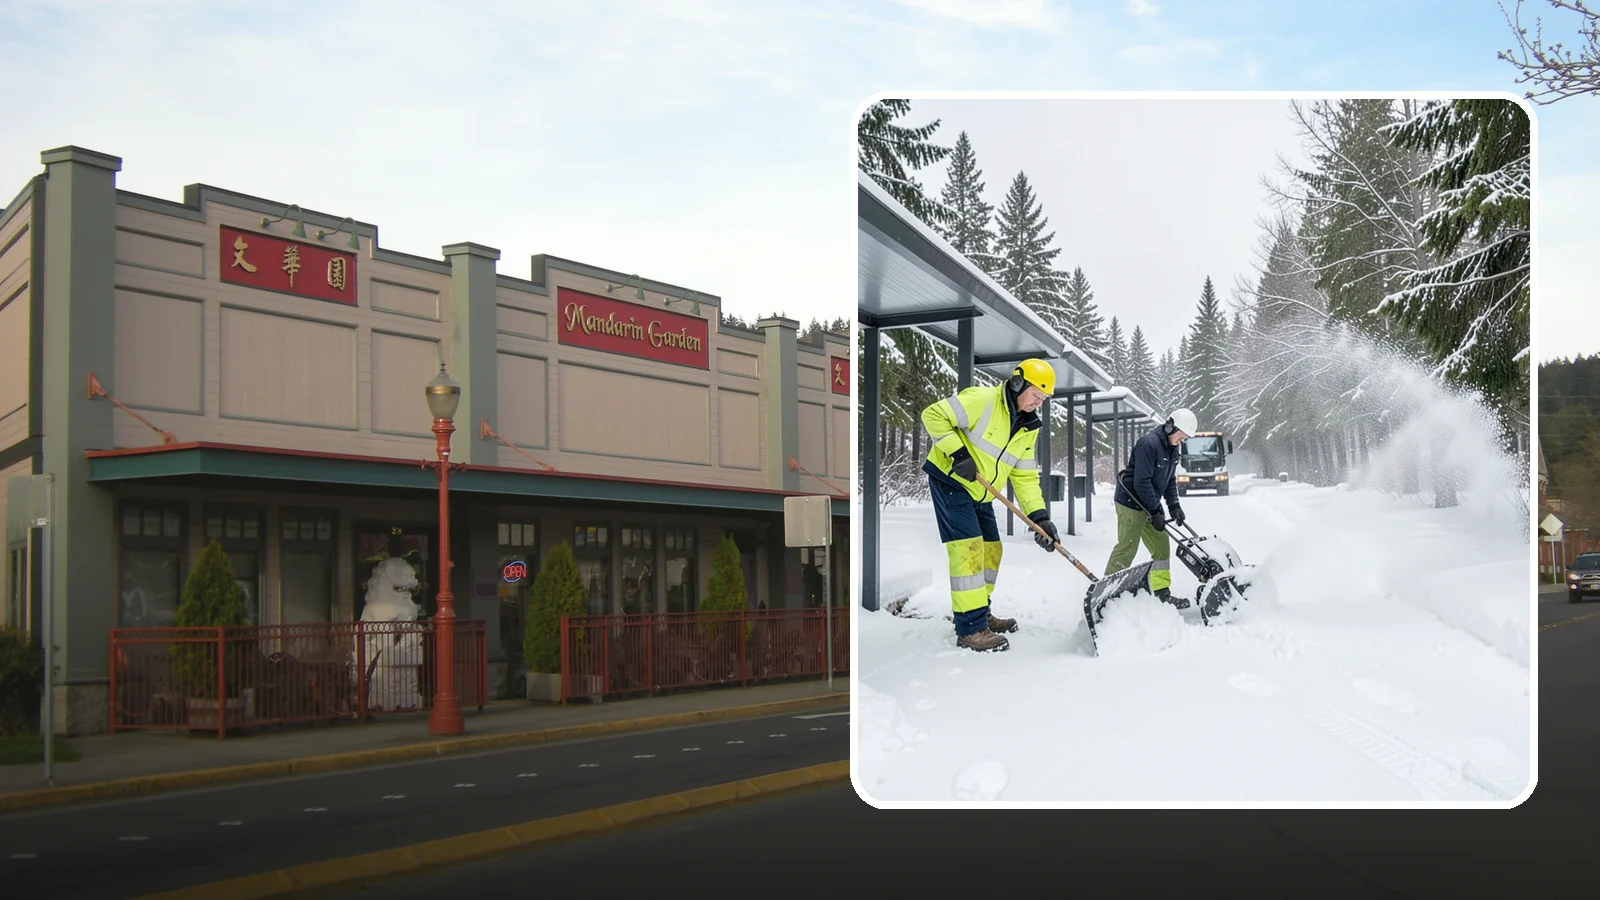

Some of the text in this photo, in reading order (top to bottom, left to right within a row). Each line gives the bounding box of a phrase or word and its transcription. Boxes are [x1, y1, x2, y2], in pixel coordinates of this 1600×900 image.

[231, 236, 346, 290] 文華園
[564, 302, 702, 352] Mandarin Garden
[503, 565, 527, 578] OPEN
